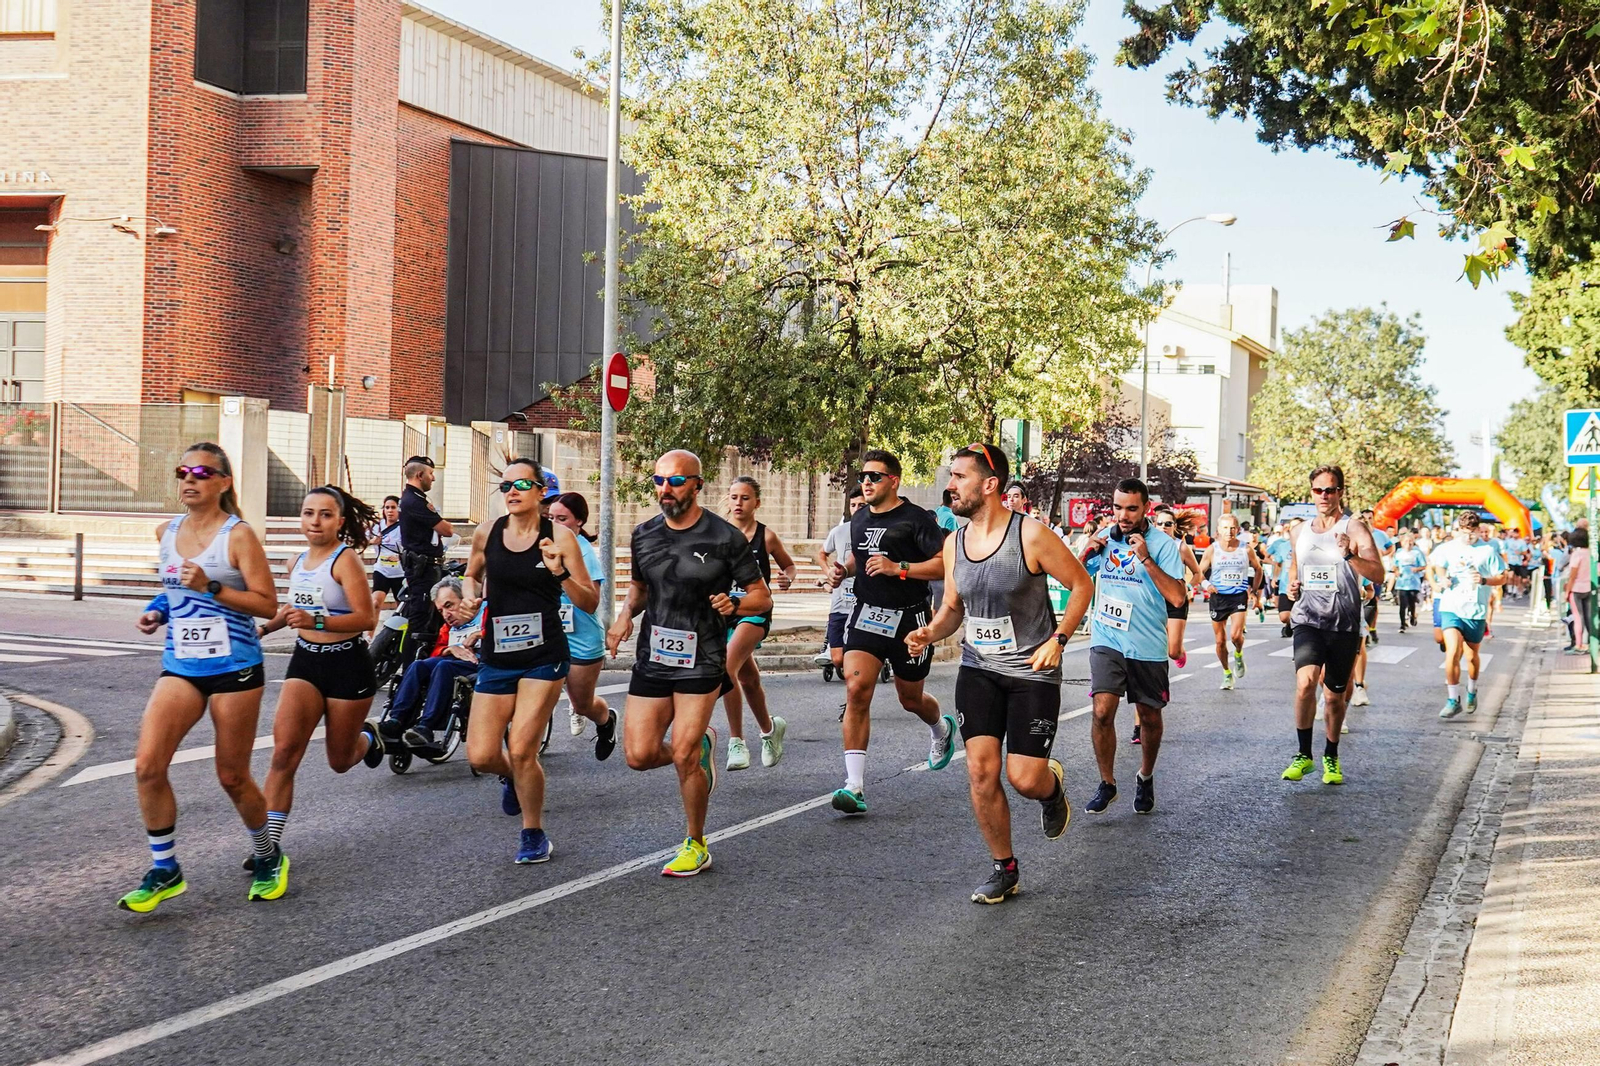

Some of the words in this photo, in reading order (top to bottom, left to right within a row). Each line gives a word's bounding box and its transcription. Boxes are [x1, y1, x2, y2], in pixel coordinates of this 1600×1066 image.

[1310, 572, 1329, 580] 545
[294, 592, 314, 605] 268
[1104, 603, 1122, 617] 110
[868, 611, 892, 624] 357
[181, 627, 212, 641] 267
[502, 623, 531, 637] 122
[976, 628, 1002, 640] 548
[320, 641, 354, 653] PRO
[659, 637, 684, 652] 123
